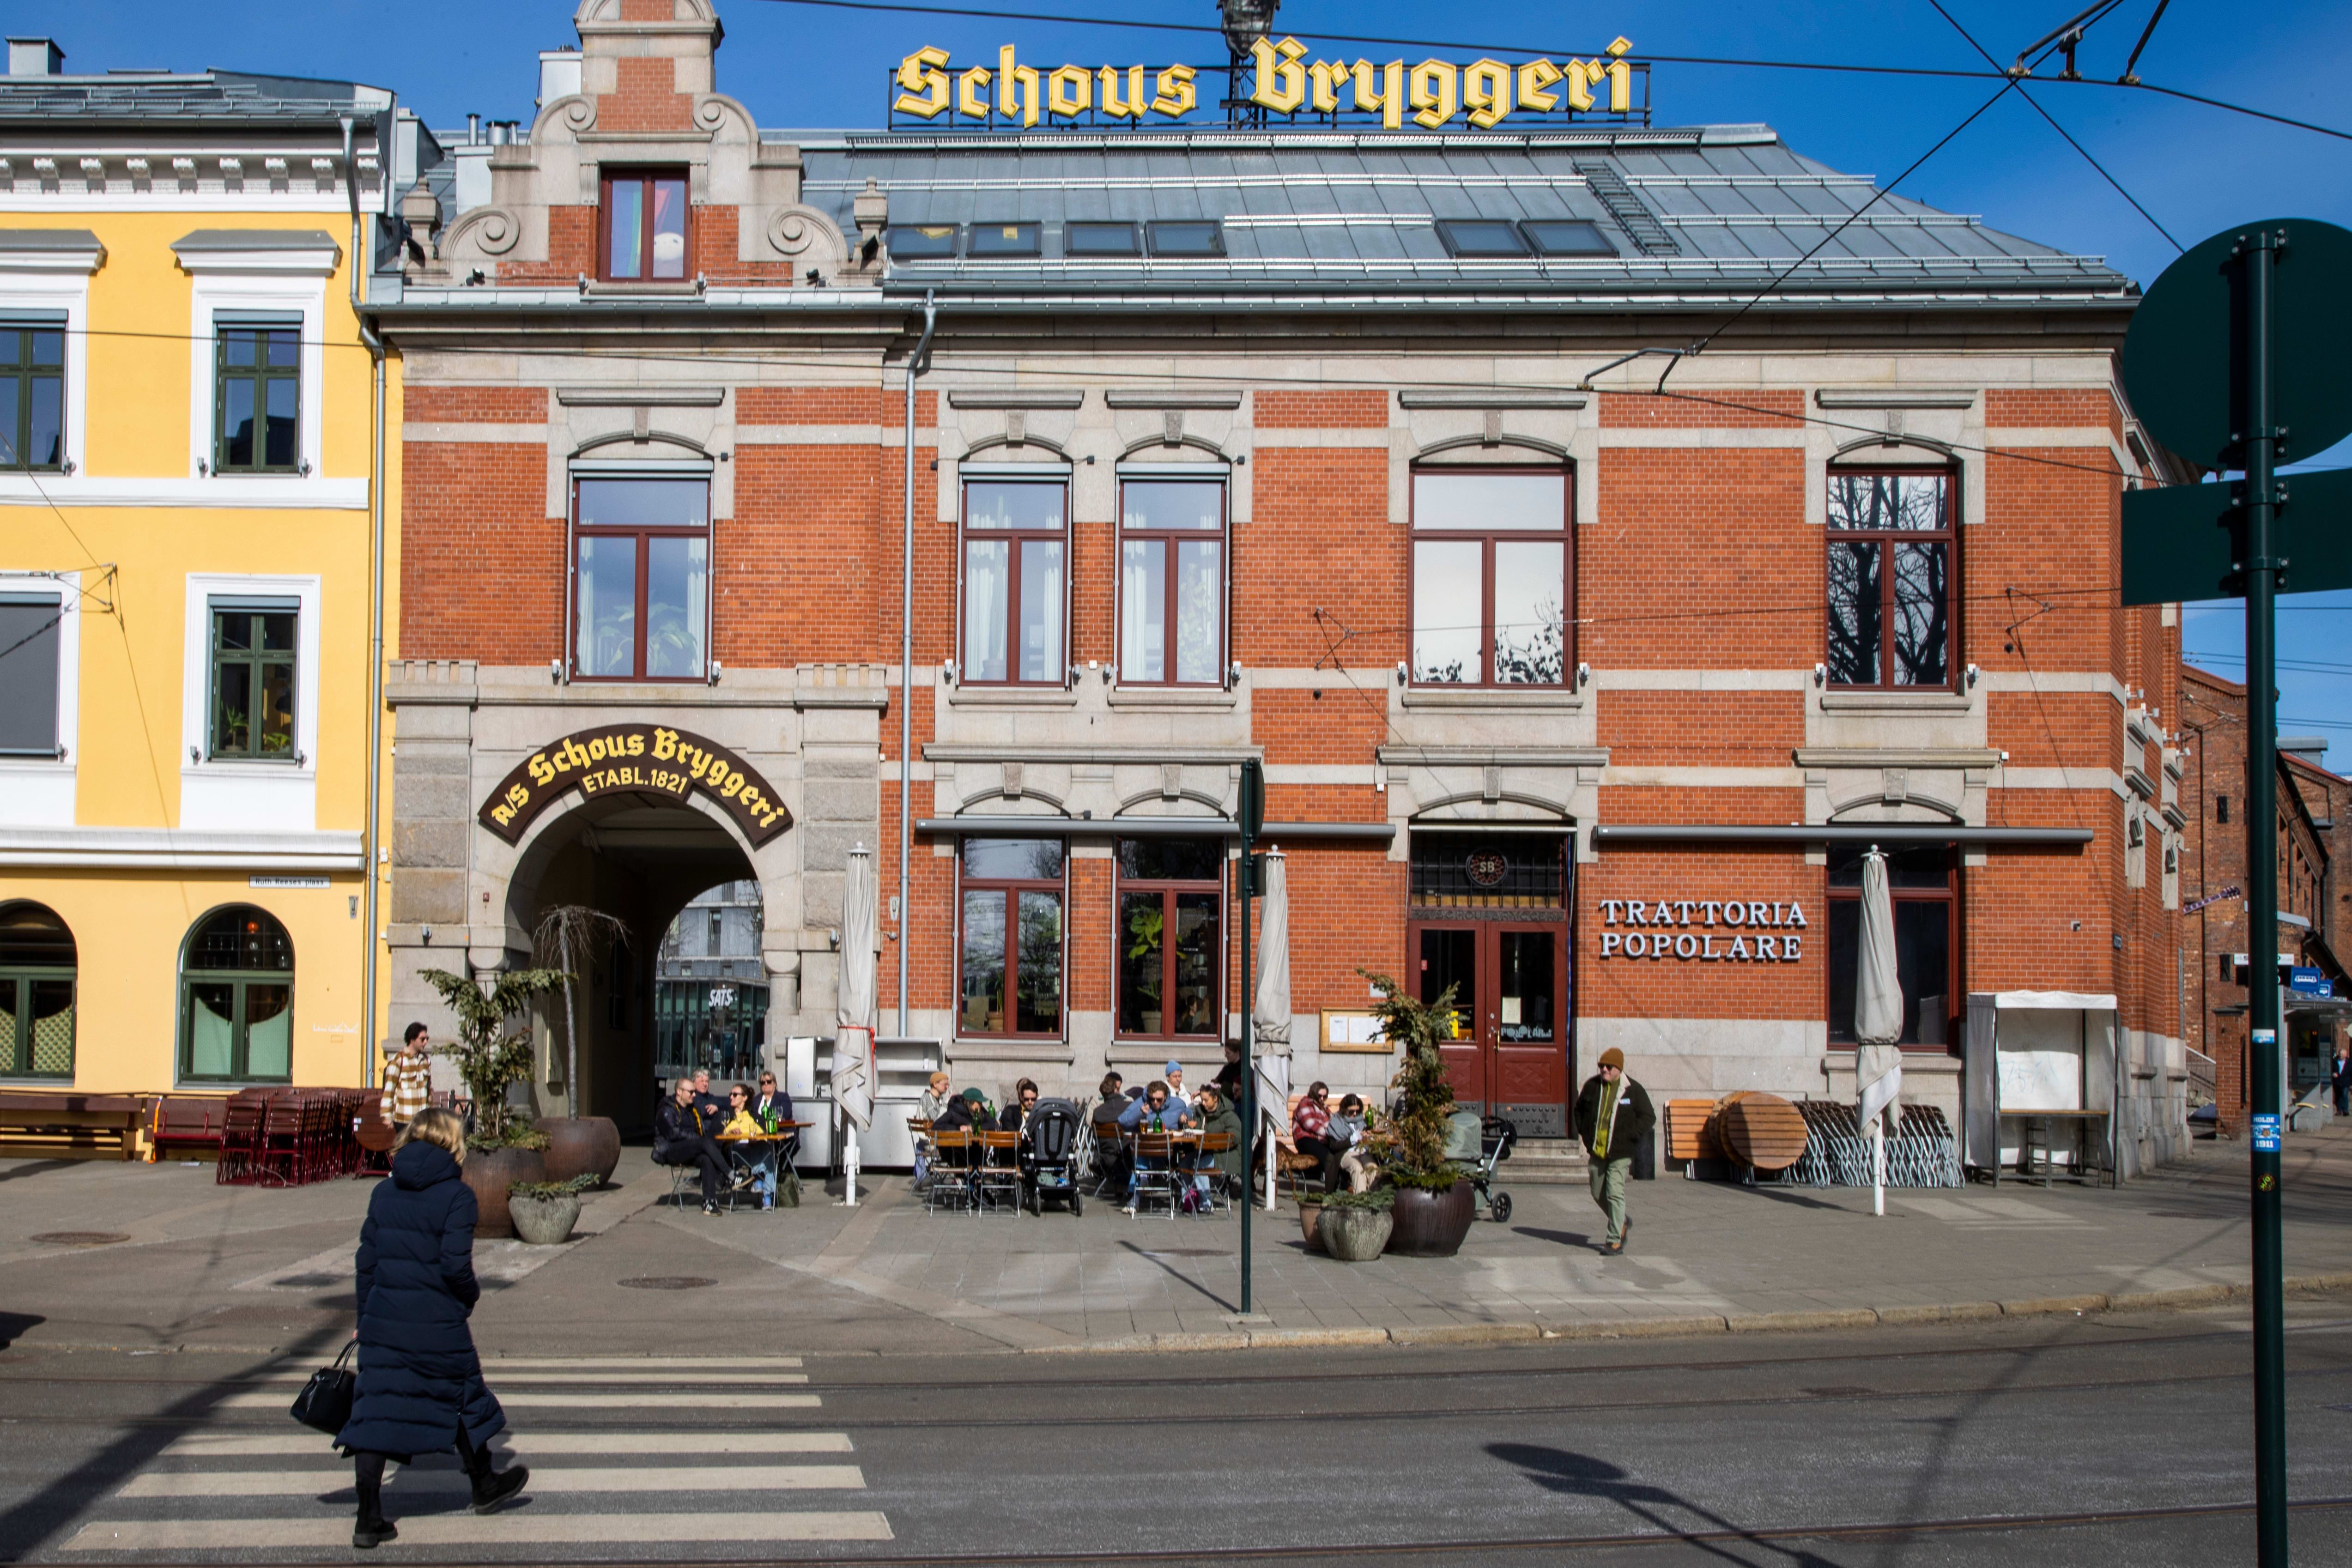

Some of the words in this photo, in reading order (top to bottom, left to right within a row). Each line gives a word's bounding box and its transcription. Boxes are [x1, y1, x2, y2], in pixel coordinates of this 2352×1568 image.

[894, 44, 1197, 128] Schous
[1250, 35, 1632, 129] Bryggeri
[528, 733, 645, 787] Schous
[651, 727, 785, 829] Bryggeri
[1479, 861, 1495, 873] SB
[305, 878, 324, 888] plass
[1599, 899, 1809, 926] TRATTORIA
[1600, 932, 1802, 960] POPOLARE
[709, 988, 733, 1007] SATS
[2255, 1139, 2273, 1148] 1911
